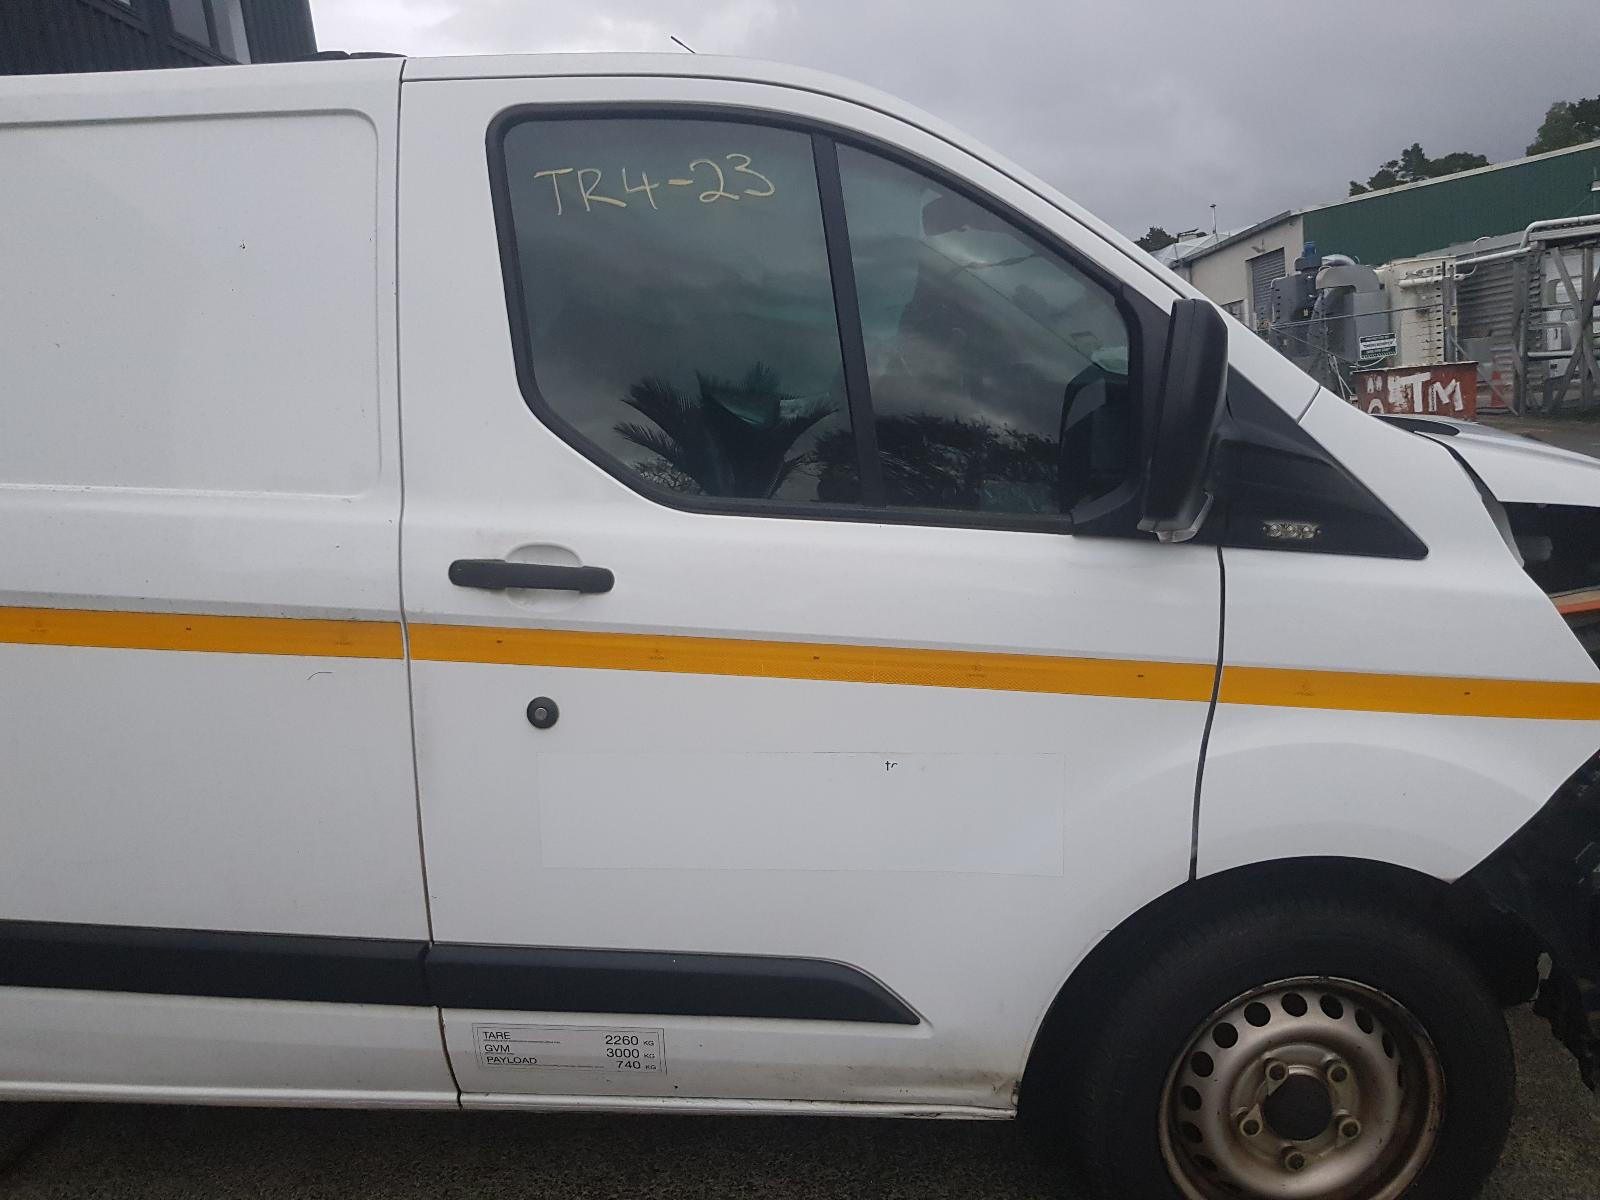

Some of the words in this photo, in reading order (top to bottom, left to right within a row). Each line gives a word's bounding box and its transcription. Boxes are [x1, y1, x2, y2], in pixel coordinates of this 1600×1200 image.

[483, 1031, 511, 1040] TARE
[605, 1034, 639, 1046] 2260
[484, 1044, 511, 1053] GVM
[606, 1047, 640, 1058] 3000
[486, 1056, 538, 1065] PAYLOAD
[616, 1060, 641, 1069] 740
